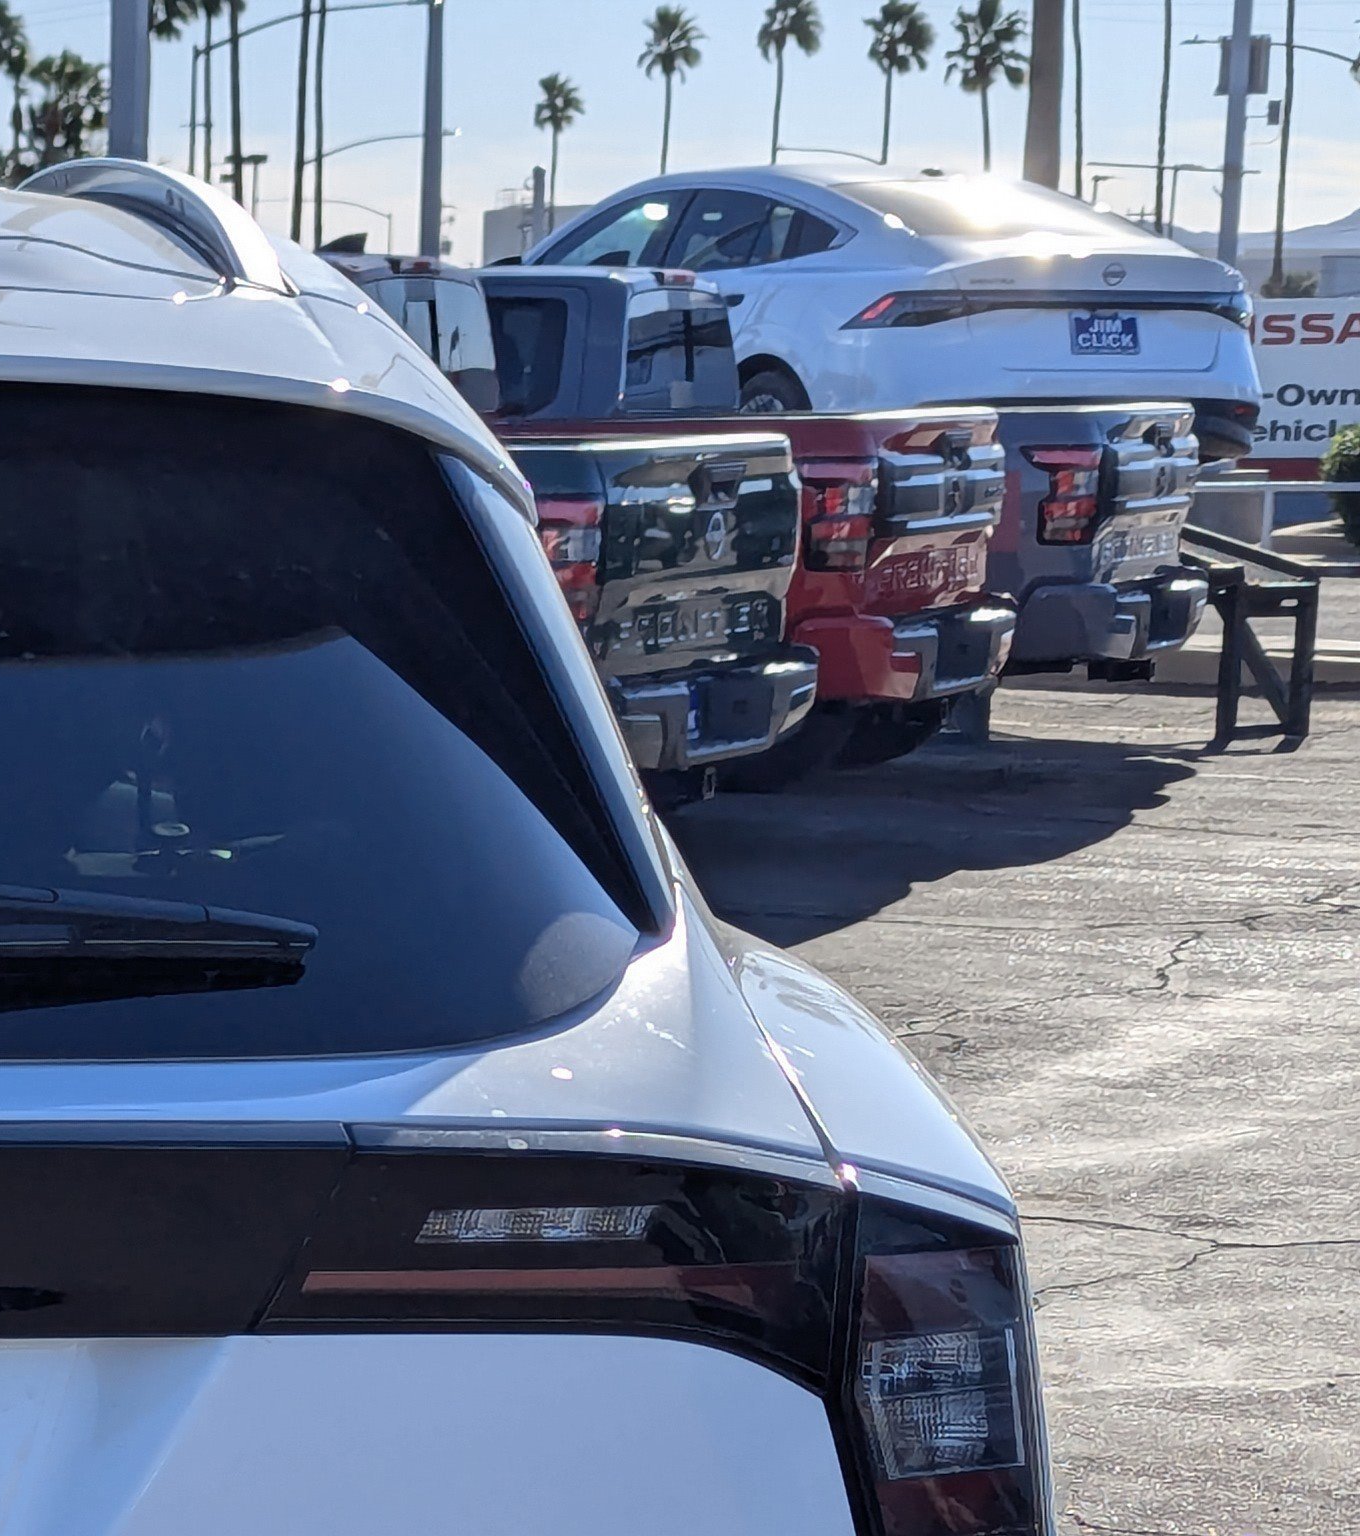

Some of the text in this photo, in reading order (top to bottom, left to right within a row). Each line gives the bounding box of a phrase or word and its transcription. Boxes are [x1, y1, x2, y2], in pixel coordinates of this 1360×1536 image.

[1089, 319, 1122, 333] JIM
[1248, 313, 1360, 345] ISSA
[1078, 332, 1134, 347] CLICK
[1262, 384, 1360, 407] -Own
[1252, 419, 1337, 442] ehicl
